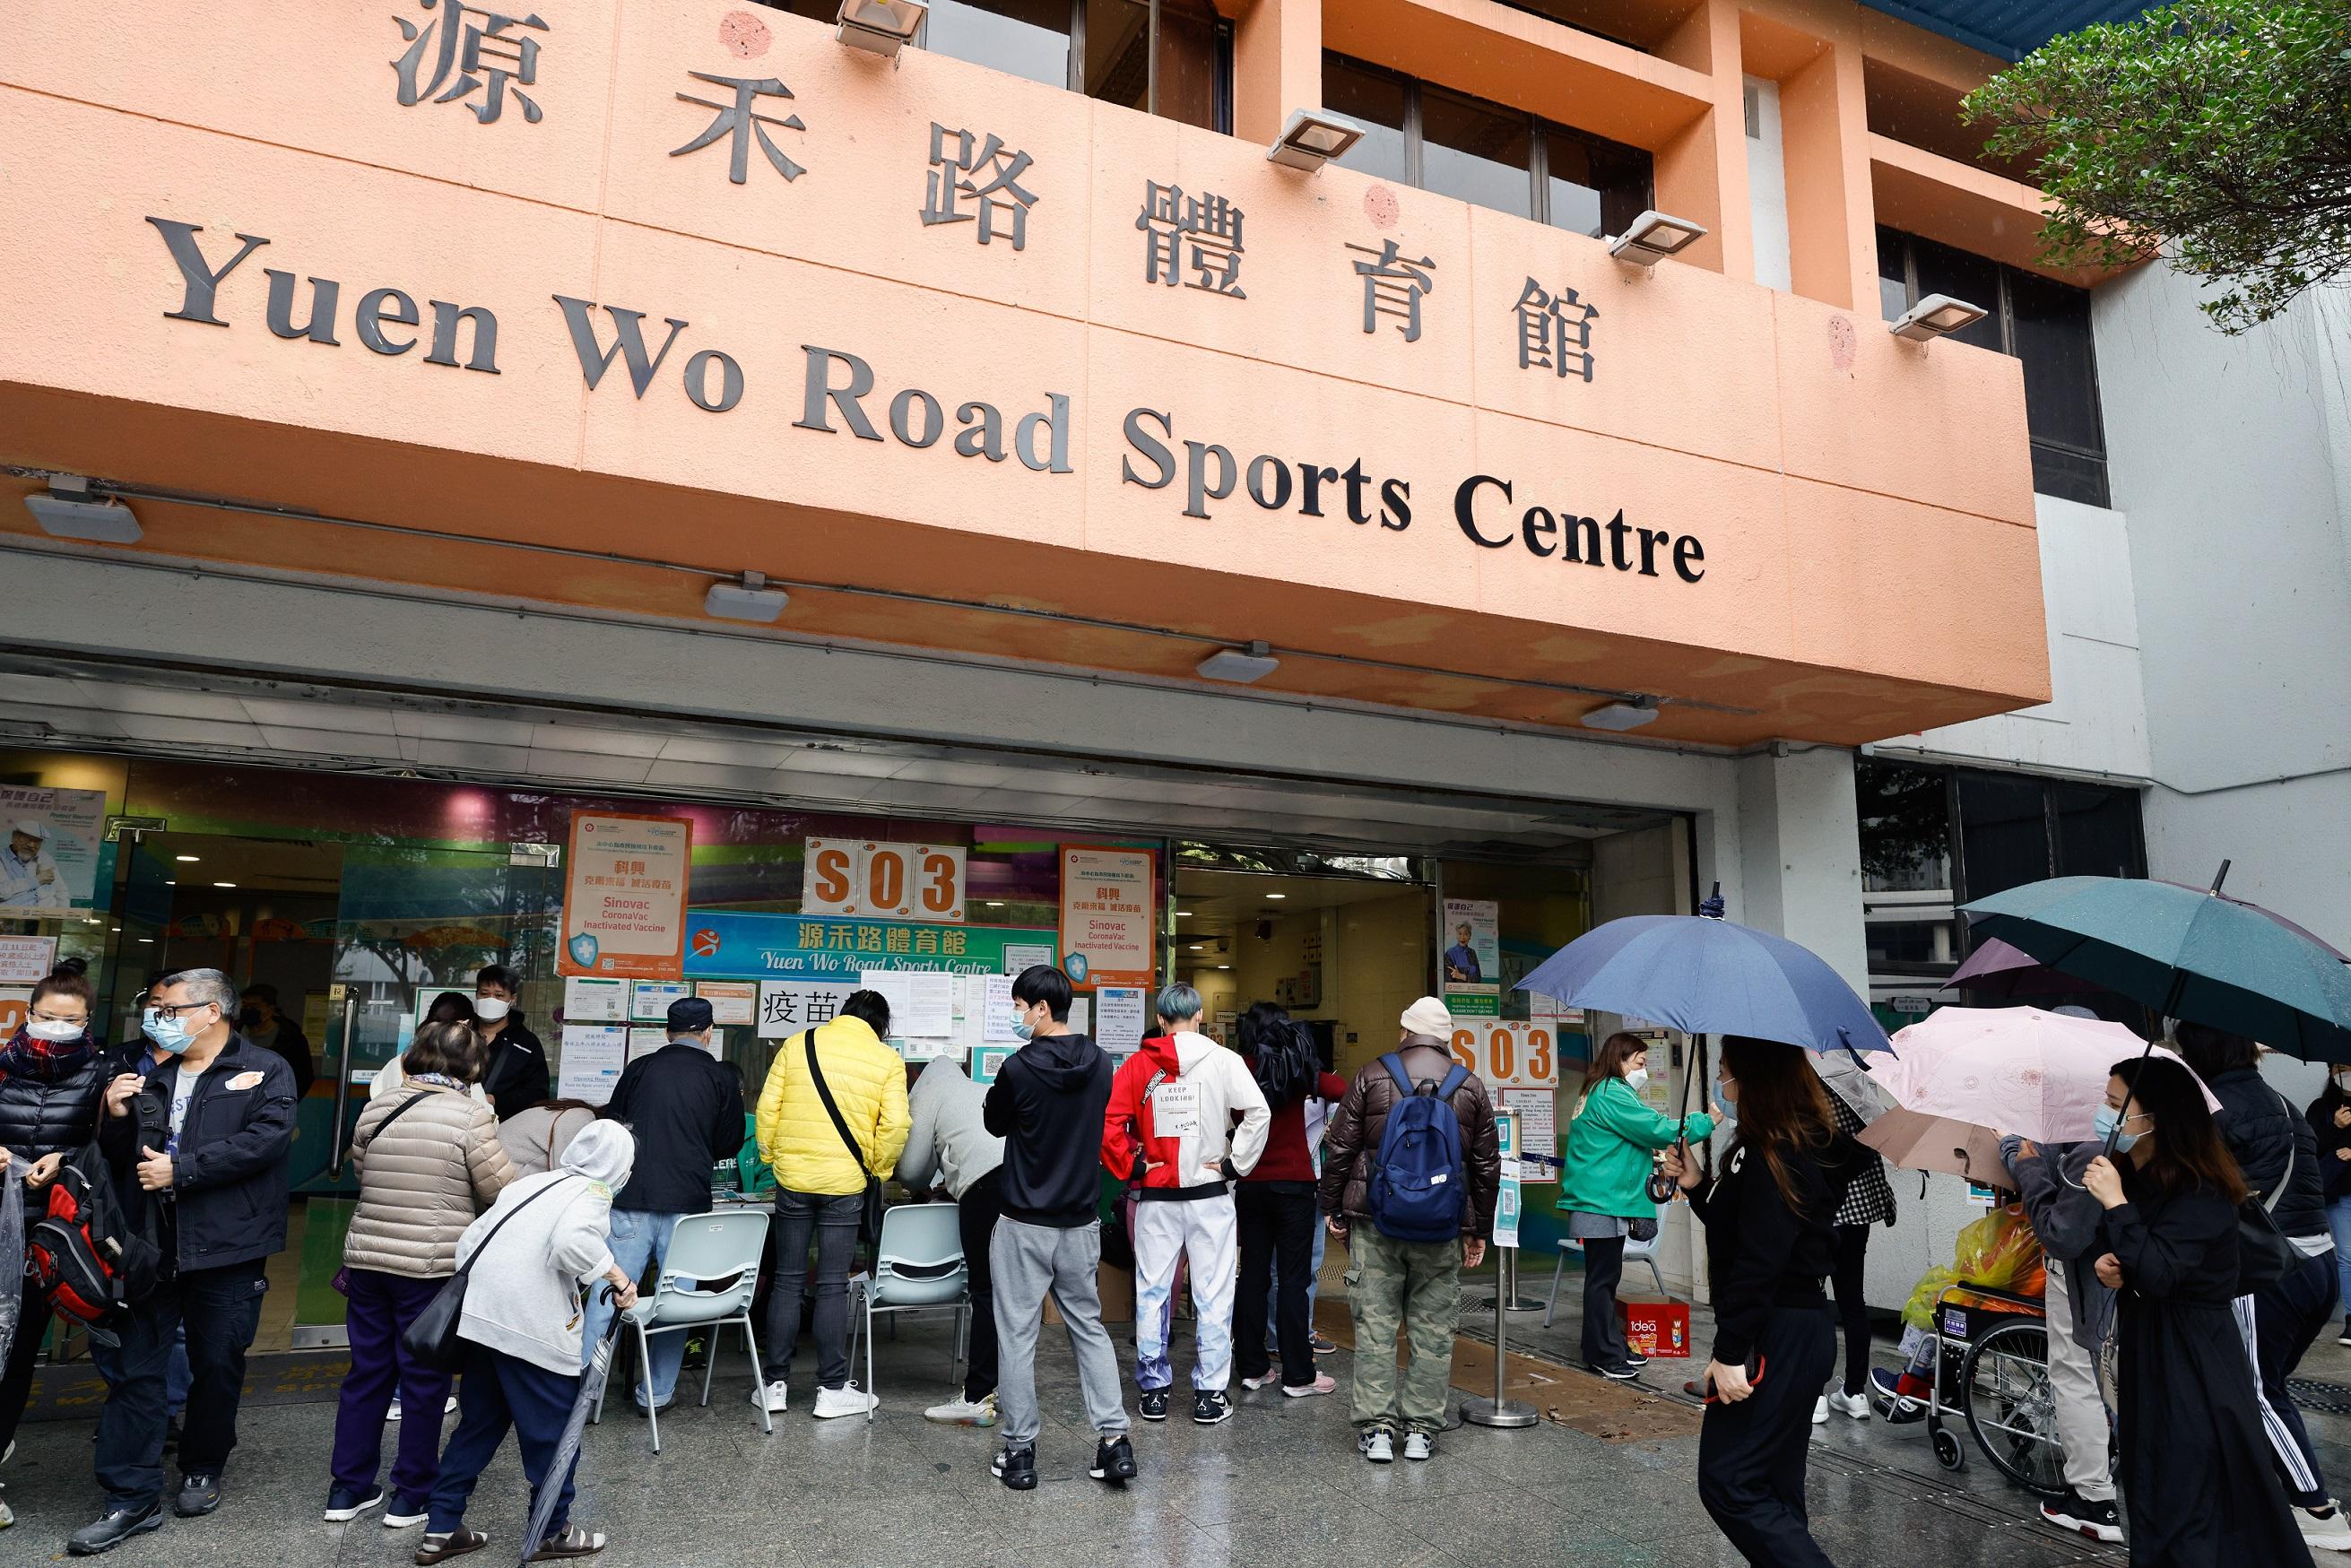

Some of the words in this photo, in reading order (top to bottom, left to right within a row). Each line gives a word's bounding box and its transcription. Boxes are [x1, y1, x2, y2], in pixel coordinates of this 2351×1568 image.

[390, 0, 1600, 383] 源禾路體育館
[145, 216, 501, 376] Yuen
[552, 294, 745, 414] Wo
[793, 344, 1074, 475] Road
[1122, 407, 1413, 533] Sports
[1453, 474, 1706, 585] Centre
[614, 860, 646, 875] 科興
[1097, 887, 1120, 900] 科興
[603, 897, 650, 910] Sinovac
[602, 910, 648, 921] CoronaVac
[584, 920, 632, 931] Inactivated
[634, 923, 666, 932] Vaccine
[1089, 920, 1126, 931] Sinovac
[798, 922, 967, 955] 源禾路體育館
[1089, 932, 1125, 940] CoronaVac
[1074, 941, 1113, 949] Inactivated
[760, 950, 804, 971] Yuen
[809, 953, 840, 972] Wo
[844, 955, 887, 971] Road
[891, 957, 940, 973] Sports
[945, 958, 992, 975] Centre
[764, 990, 850, 1024] 疫苗
[1631, 1320, 1657, 1332] idea
